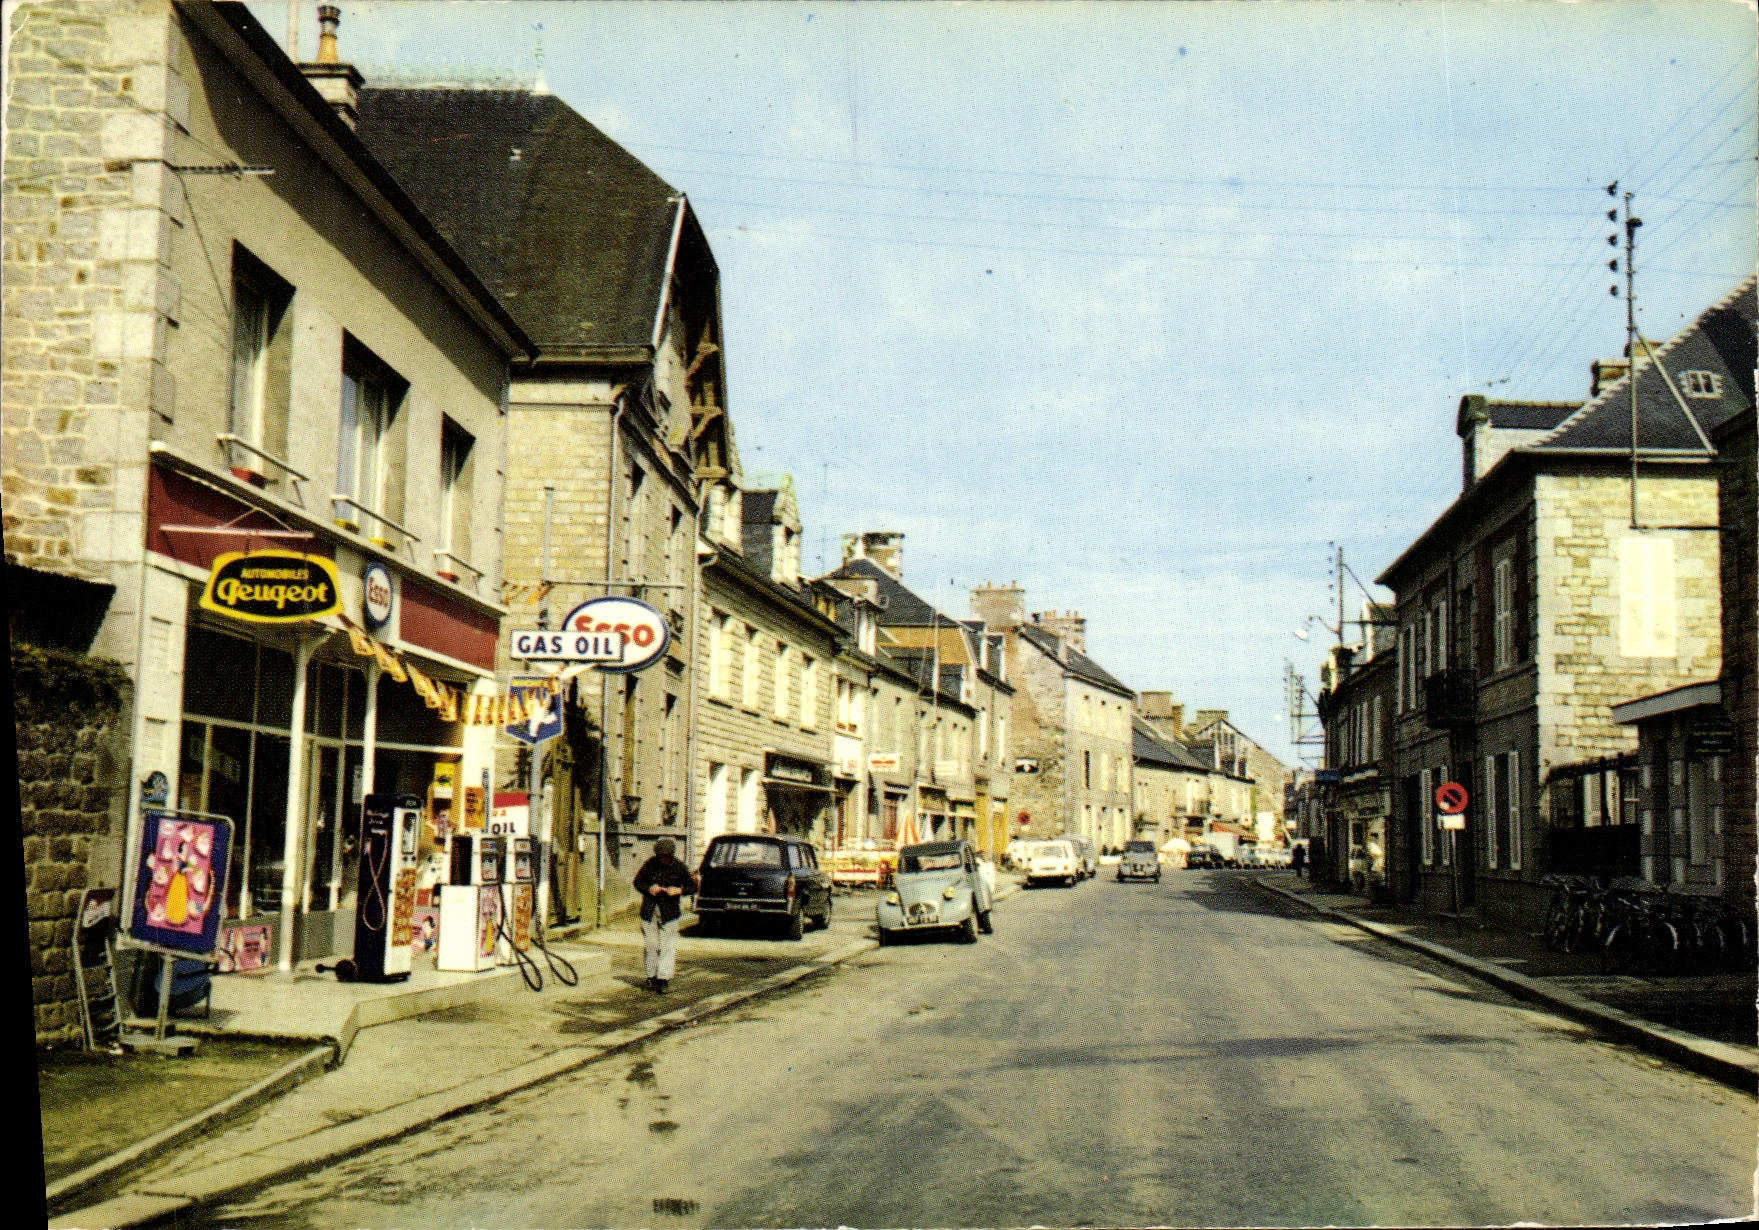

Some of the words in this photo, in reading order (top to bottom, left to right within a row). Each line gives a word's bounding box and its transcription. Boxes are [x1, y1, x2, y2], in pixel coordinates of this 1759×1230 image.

[216, 577, 329, 610] Peugeot
[517, 635, 563, 655] GAS
[575, 636, 614, 656] OIL
[491, 821, 516, 836] OIL
